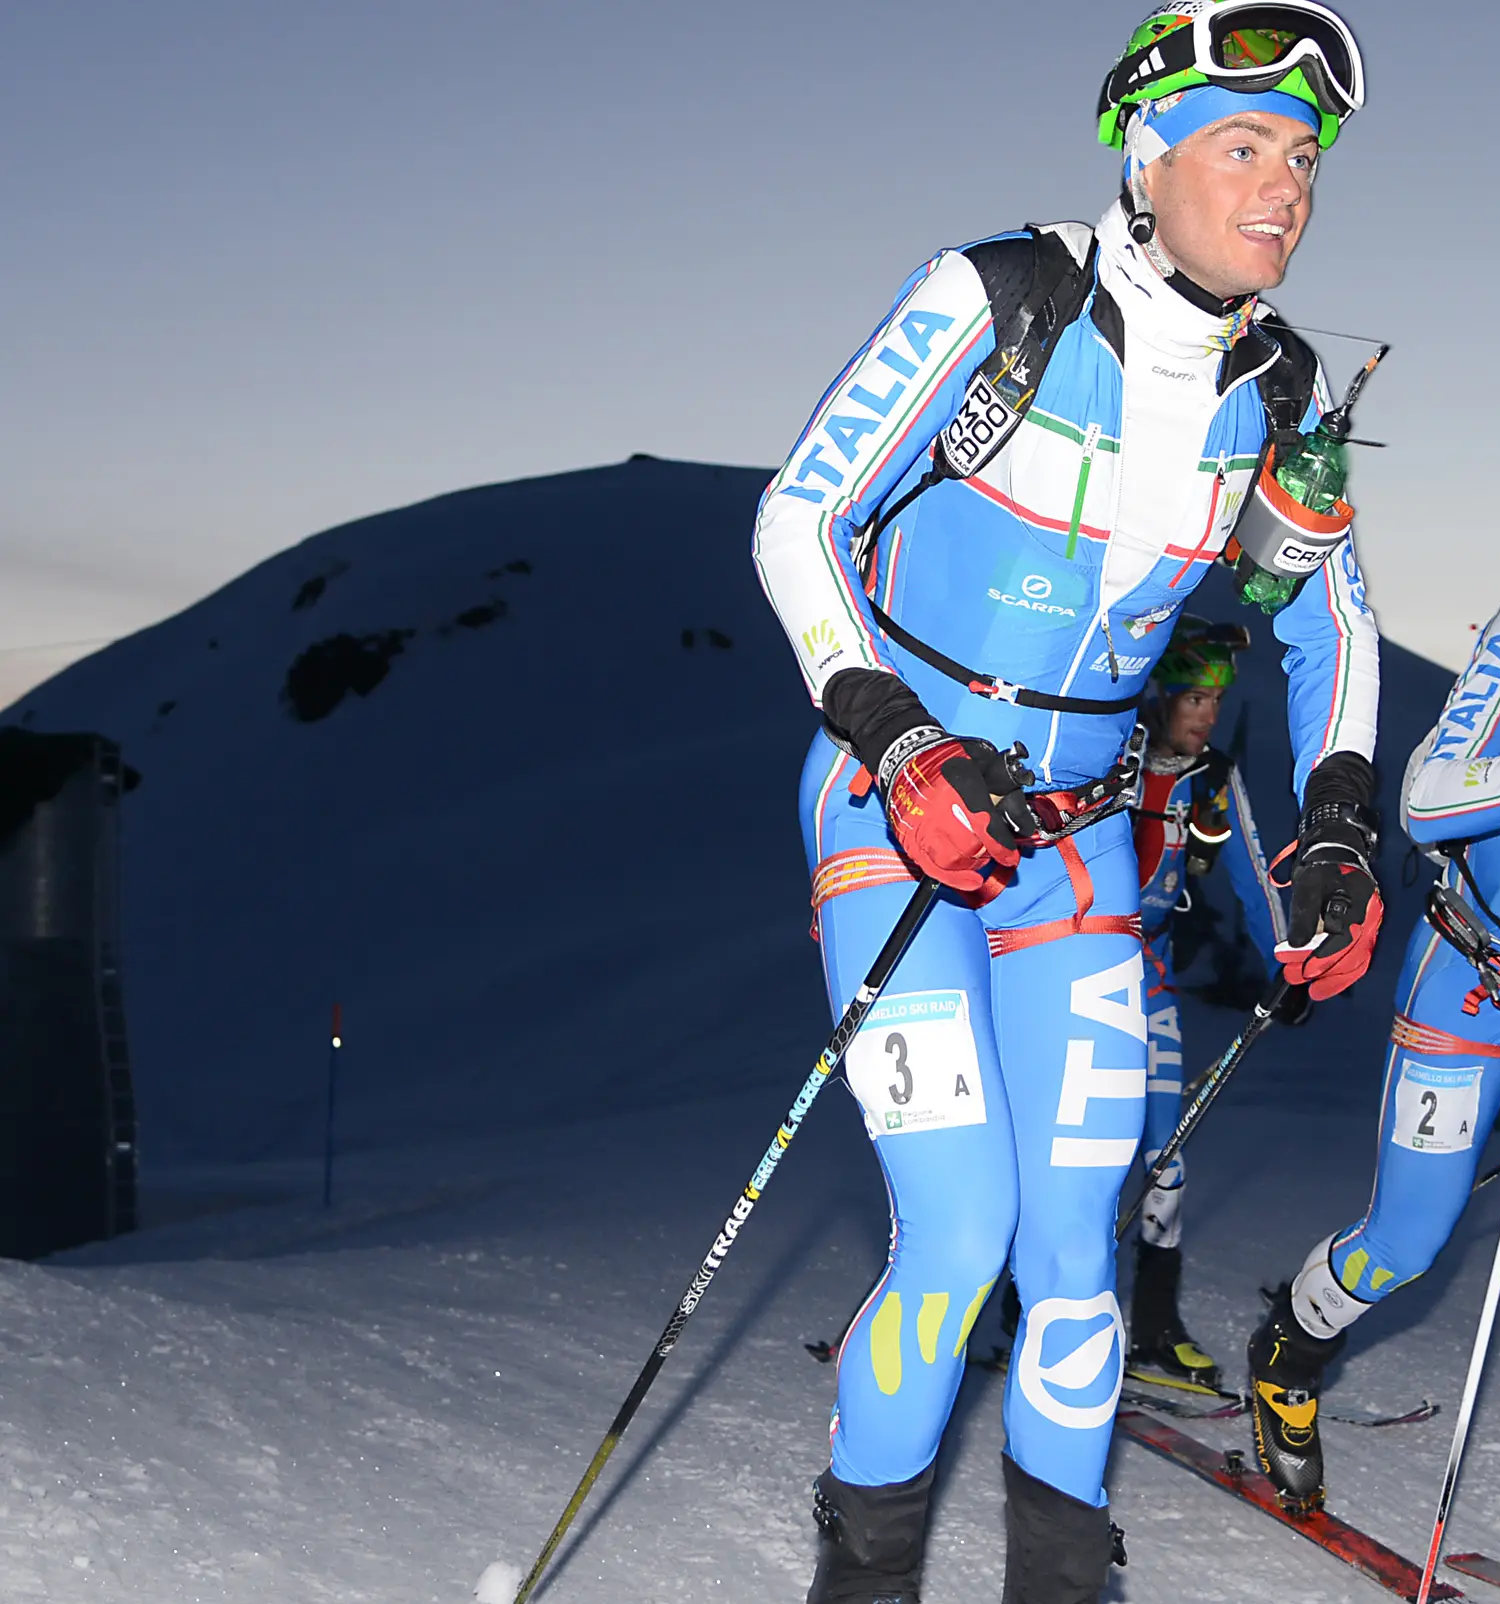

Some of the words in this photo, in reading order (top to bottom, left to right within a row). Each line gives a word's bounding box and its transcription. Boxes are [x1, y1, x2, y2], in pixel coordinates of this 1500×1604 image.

[1151, 365, 1189, 380] CRAFT
[780, 310, 956, 504] ITALIA
[953, 456, 971, 473] MADE
[1282, 545, 1327, 563] CRA
[987, 588, 1076, 617] SCARPA
[895, 785, 924, 816] CAMP
[866, 1005, 906, 1022] AMELLO
[909, 1003, 928, 1014] SKI
[931, 1000, 956, 1013] RAID
[1050, 949, 1147, 1167] ITA
[1147, 1005, 1182, 1094] ITA
[884, 1032, 913, 1105] 3
[789, 1047, 837, 1123] CARBON
[954, 1073, 971, 1097] A
[1417, 1090, 1437, 1136] 2
[1459, 1120, 1468, 1135] A
